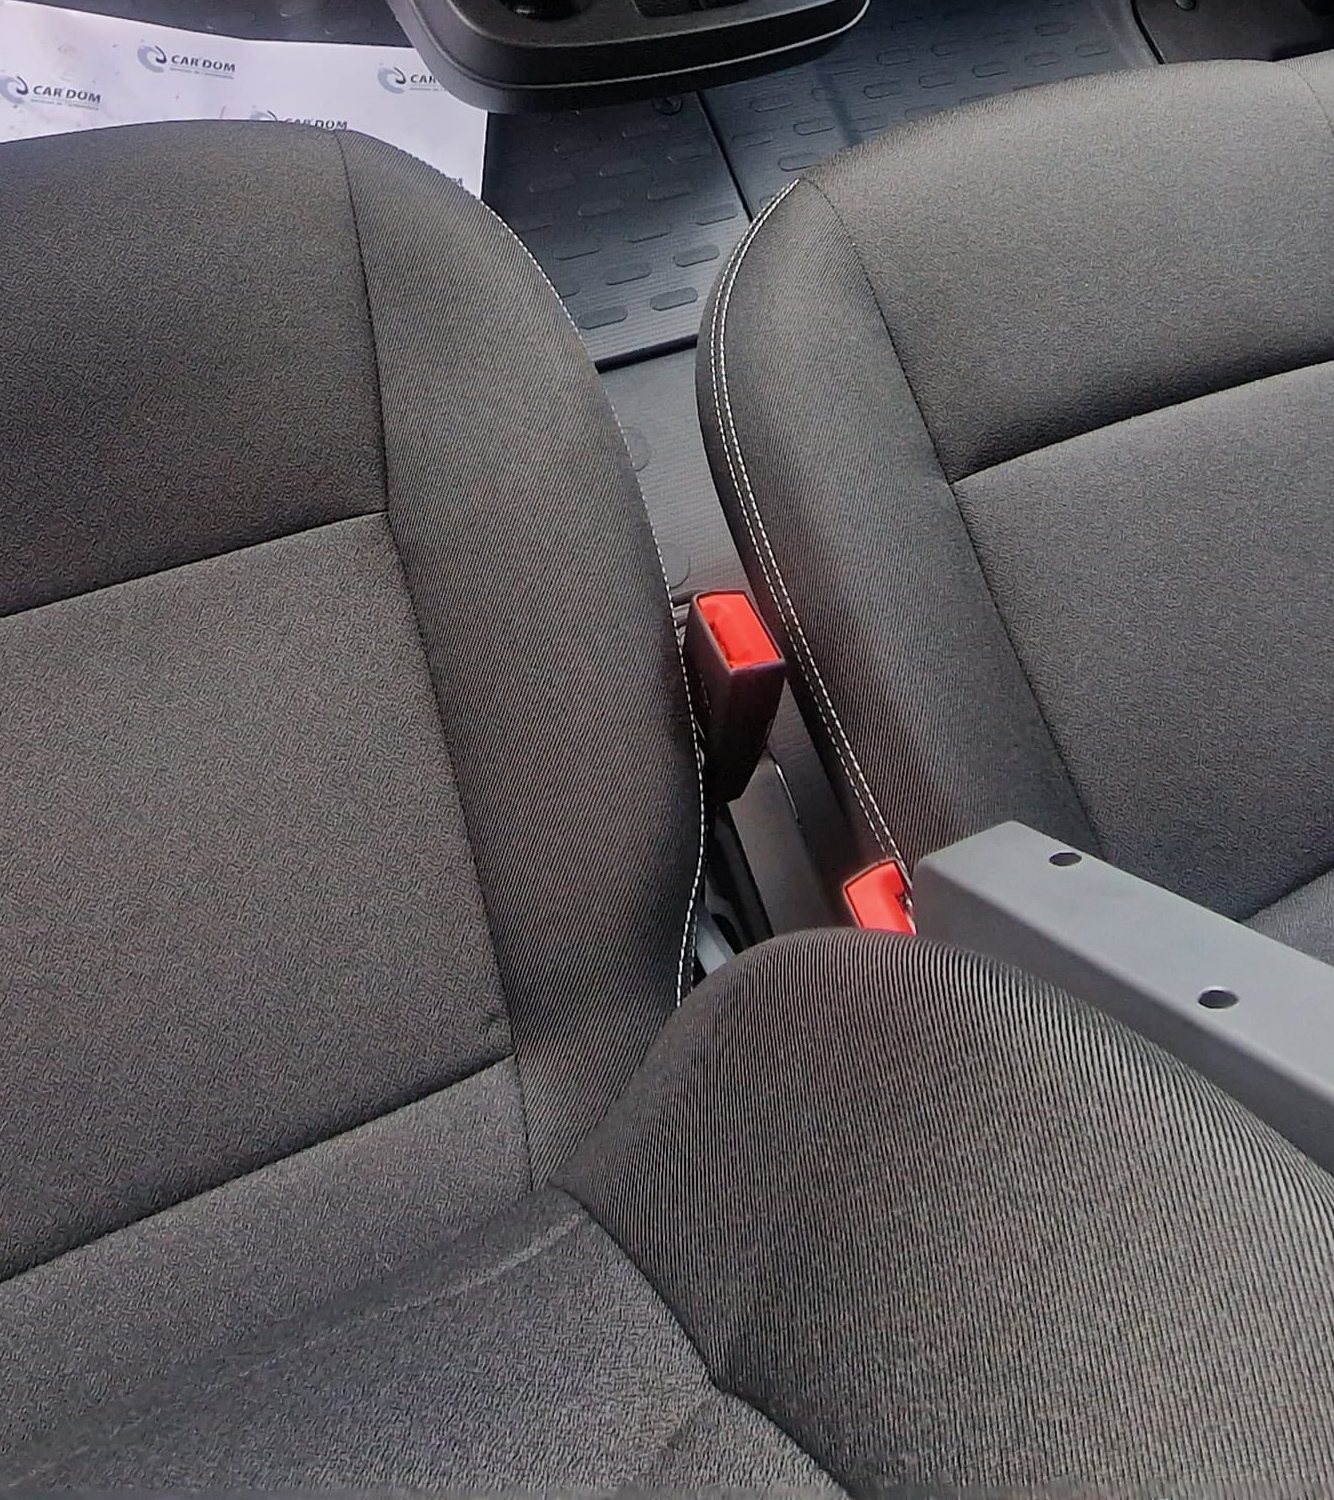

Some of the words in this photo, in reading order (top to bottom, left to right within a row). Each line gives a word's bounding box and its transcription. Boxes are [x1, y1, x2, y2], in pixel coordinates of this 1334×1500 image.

[170, 54, 200, 67] CAR
[202, 59, 236, 73] DOM
[33, 85, 63, 98] CAR
[65, 88, 101, 103] DOM
